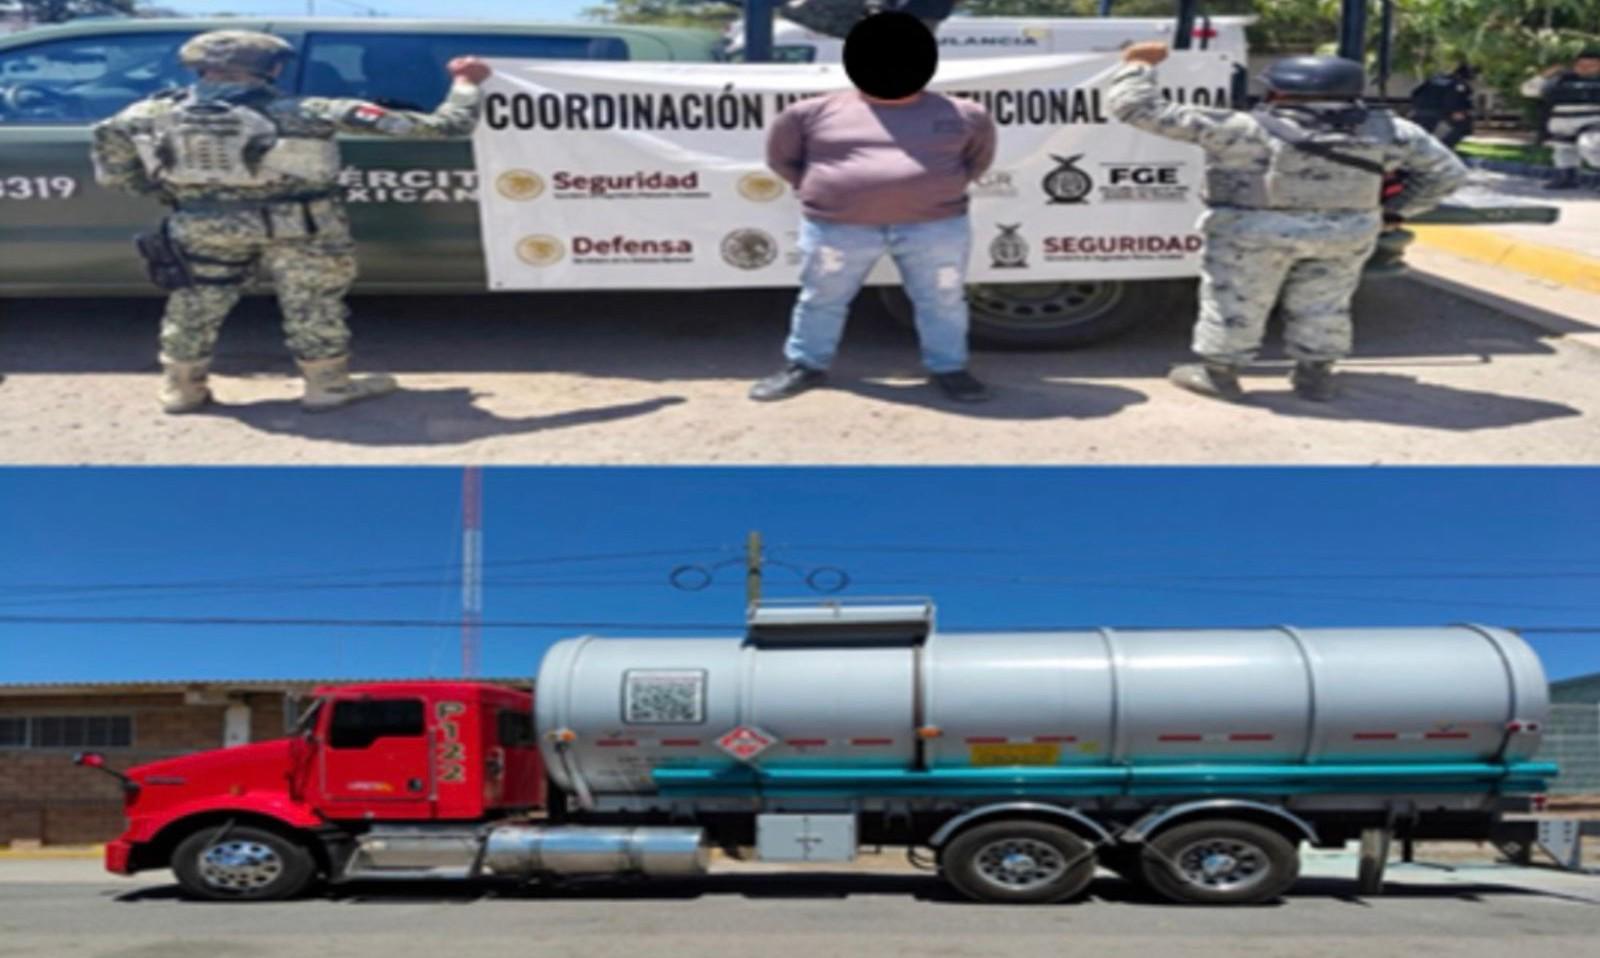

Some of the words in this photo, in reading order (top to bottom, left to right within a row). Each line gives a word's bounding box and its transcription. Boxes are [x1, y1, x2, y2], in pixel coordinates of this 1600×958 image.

[486, 83, 764, 130] COORDINACIÓN
[553, 171, 699, 194] Seguridad
[1110, 167, 1178, 184] FGE
[572, 235, 693, 255] Defensa
[1043, 235, 1203, 253] SEGURIDAD
